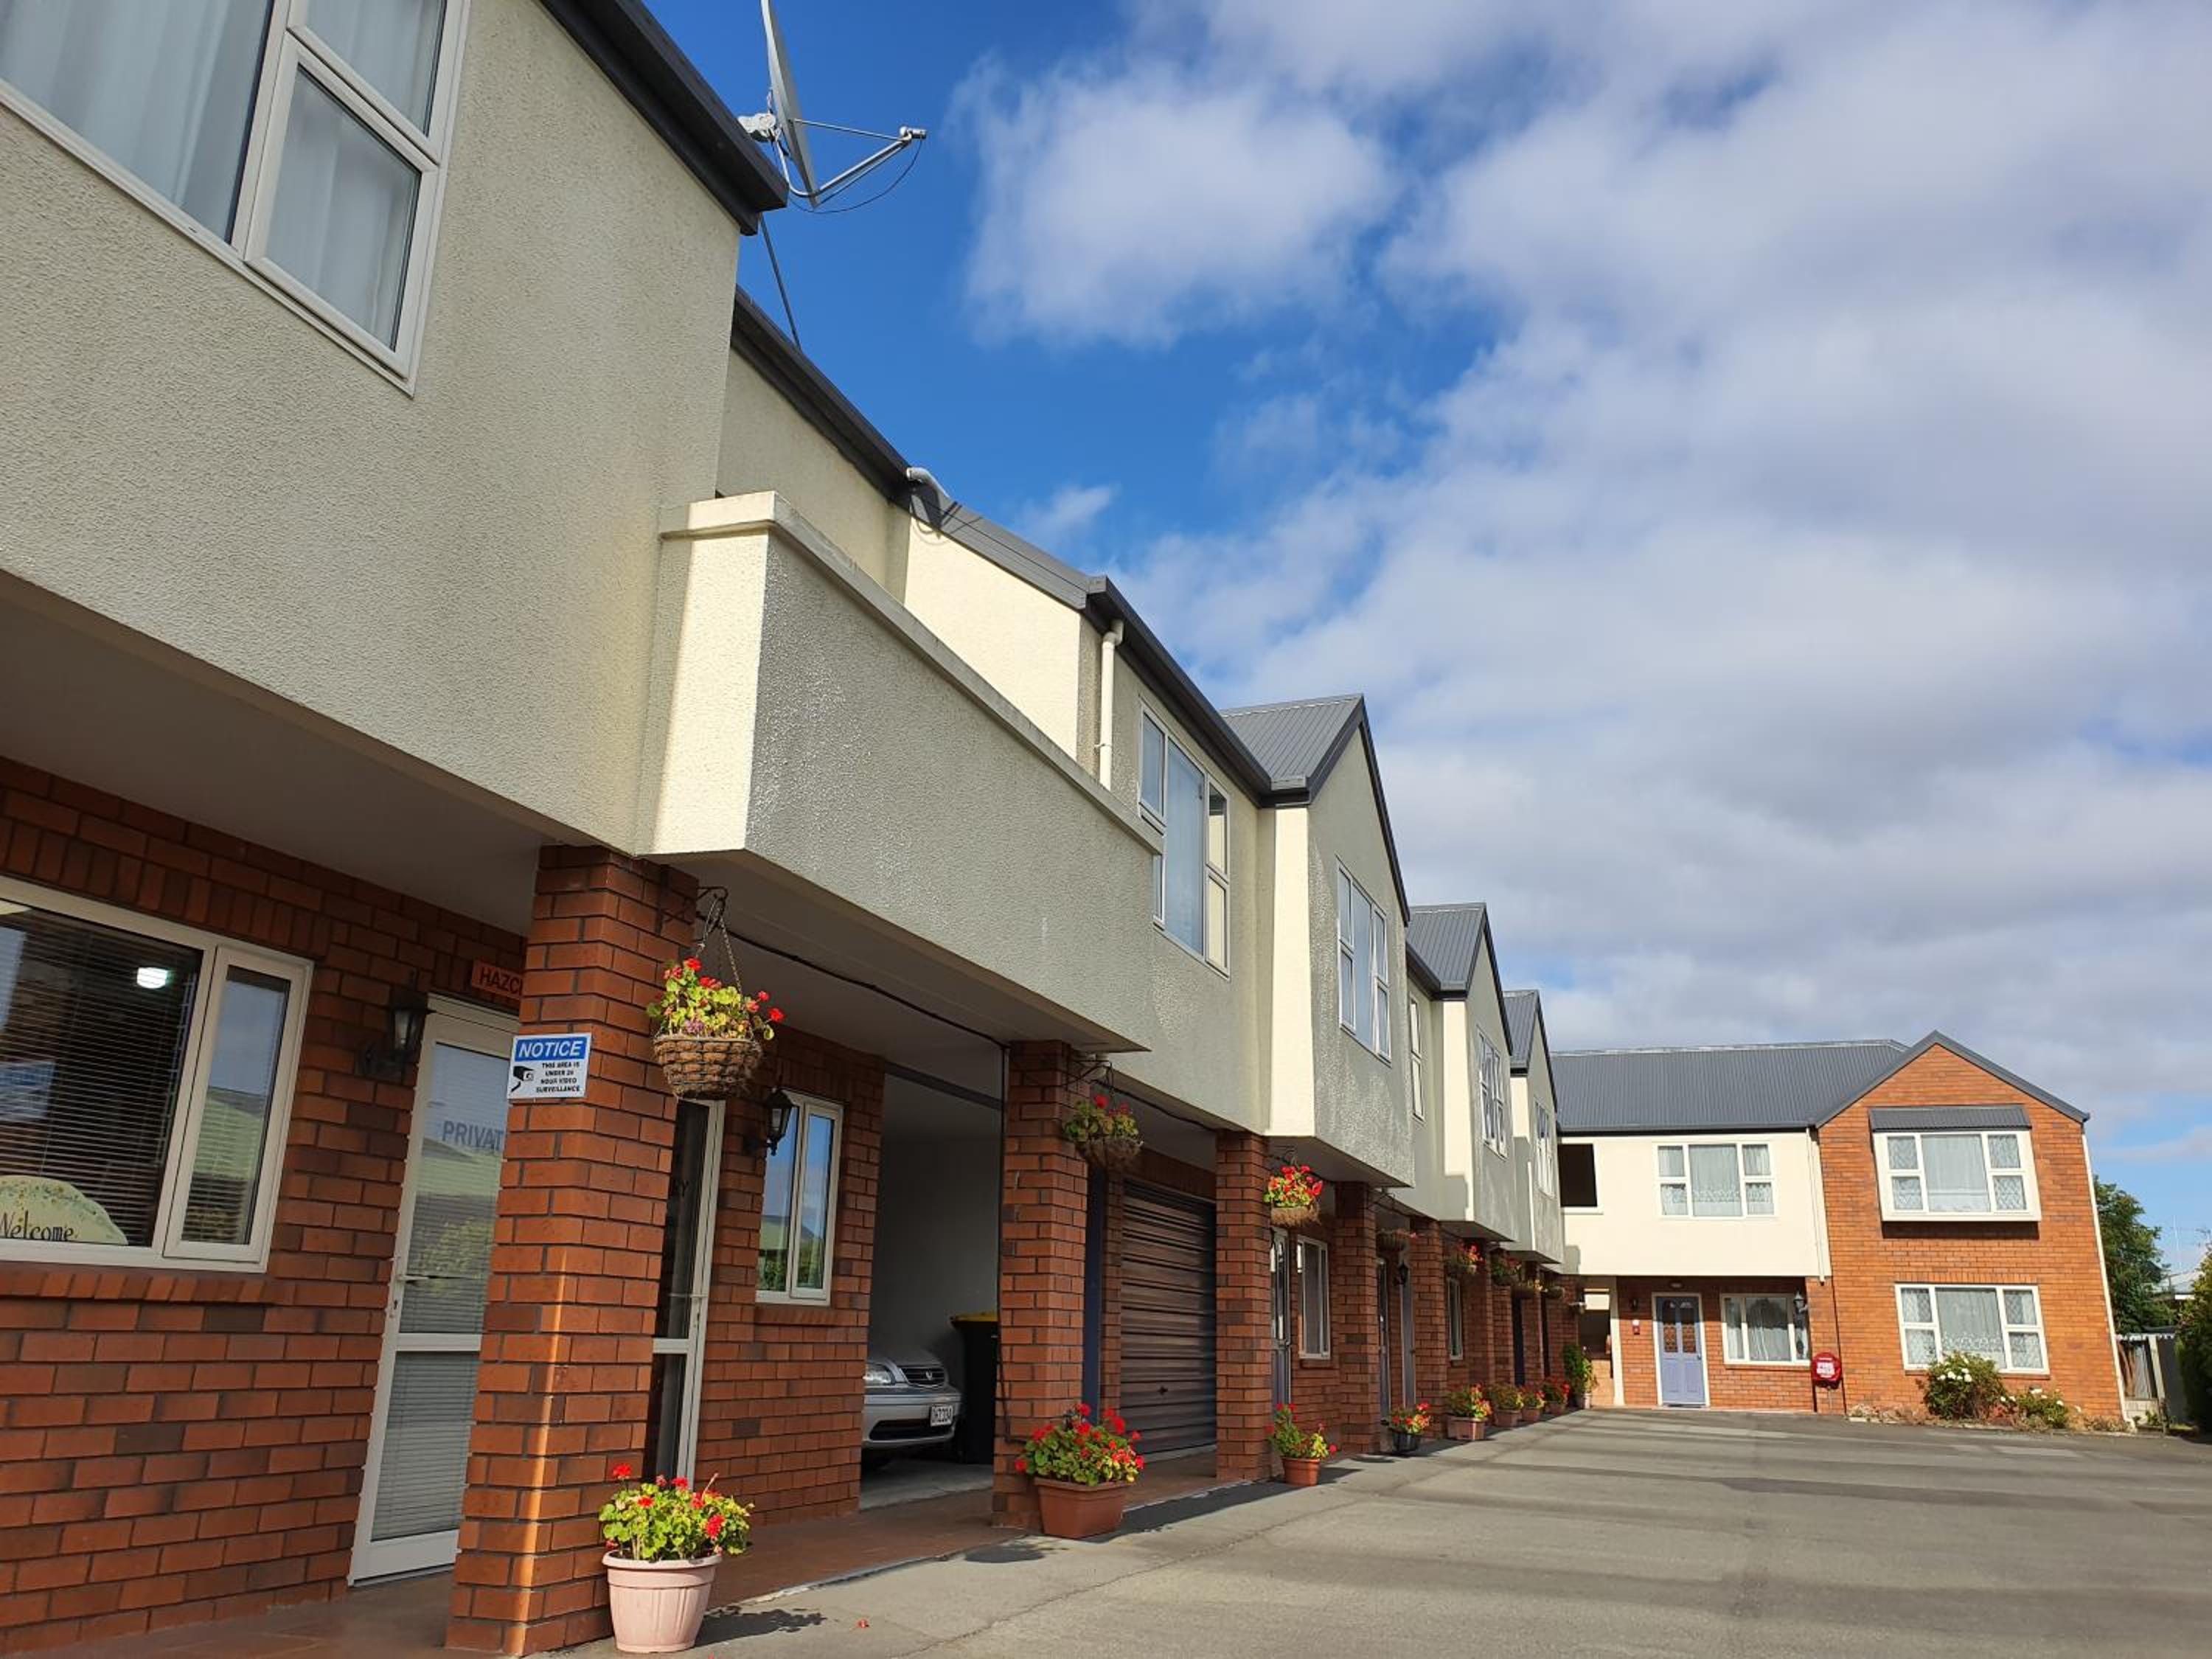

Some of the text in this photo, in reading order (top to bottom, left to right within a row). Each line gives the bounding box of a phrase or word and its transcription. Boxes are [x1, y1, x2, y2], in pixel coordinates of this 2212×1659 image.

[480, 966, 521, 994] HAZC
[518, 1040, 582, 1057] NOTICE
[442, 1120, 504, 1151] PRIVAT
